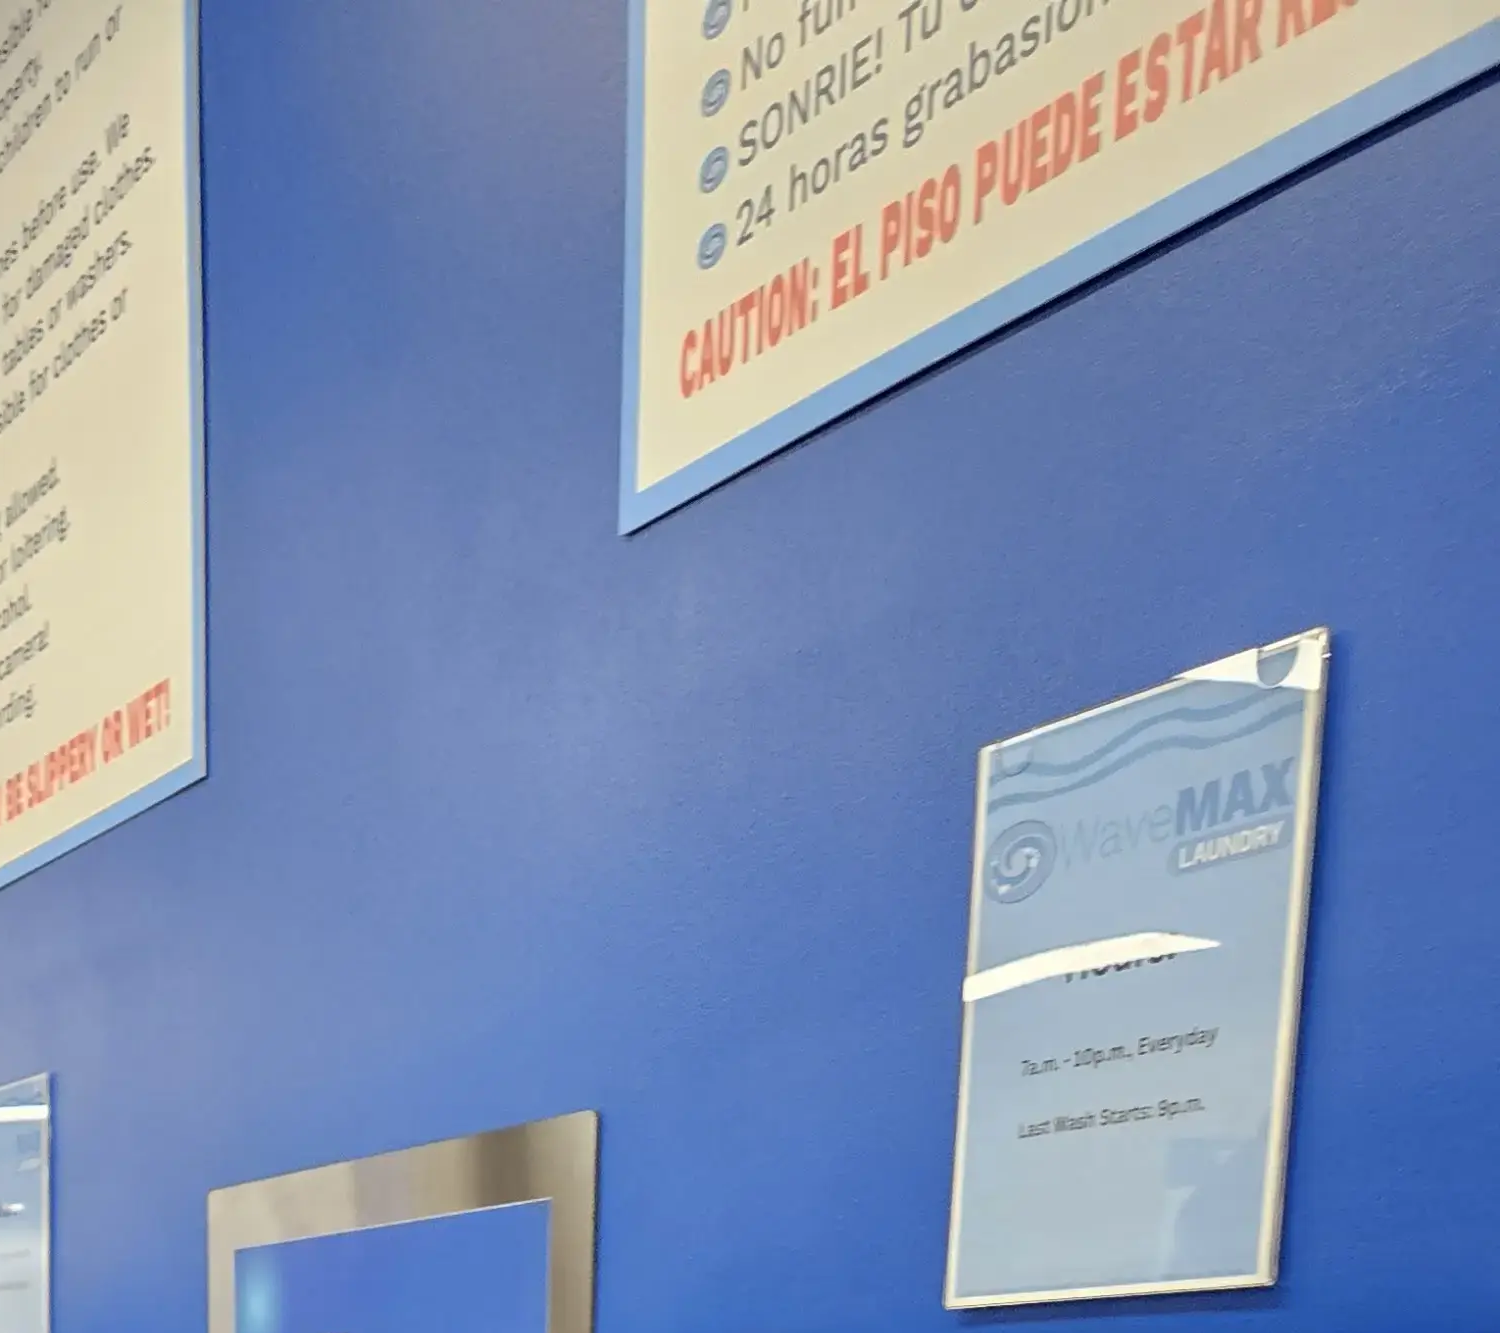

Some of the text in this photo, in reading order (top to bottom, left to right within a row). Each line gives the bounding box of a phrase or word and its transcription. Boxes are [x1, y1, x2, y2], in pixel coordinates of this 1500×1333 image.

[738, 28, 883, 166] SONRIE!
[740, 32, 785, 90] No
[680, 0, 1262, 398] CAUTION: EL PISO PUEDE ESTAR
[736, 184, 775, 246] 24
[789, 117, 888, 212] horas
[1061, 756, 1296, 872] WaveMAX
[1178, 820, 1285, 869] LAUNDRY
[1137, 1025, 1220, 1055] Everyday
[1018, 1119, 1050, 1139] Last
[1052, 1112, 1095, 1133] Wash
